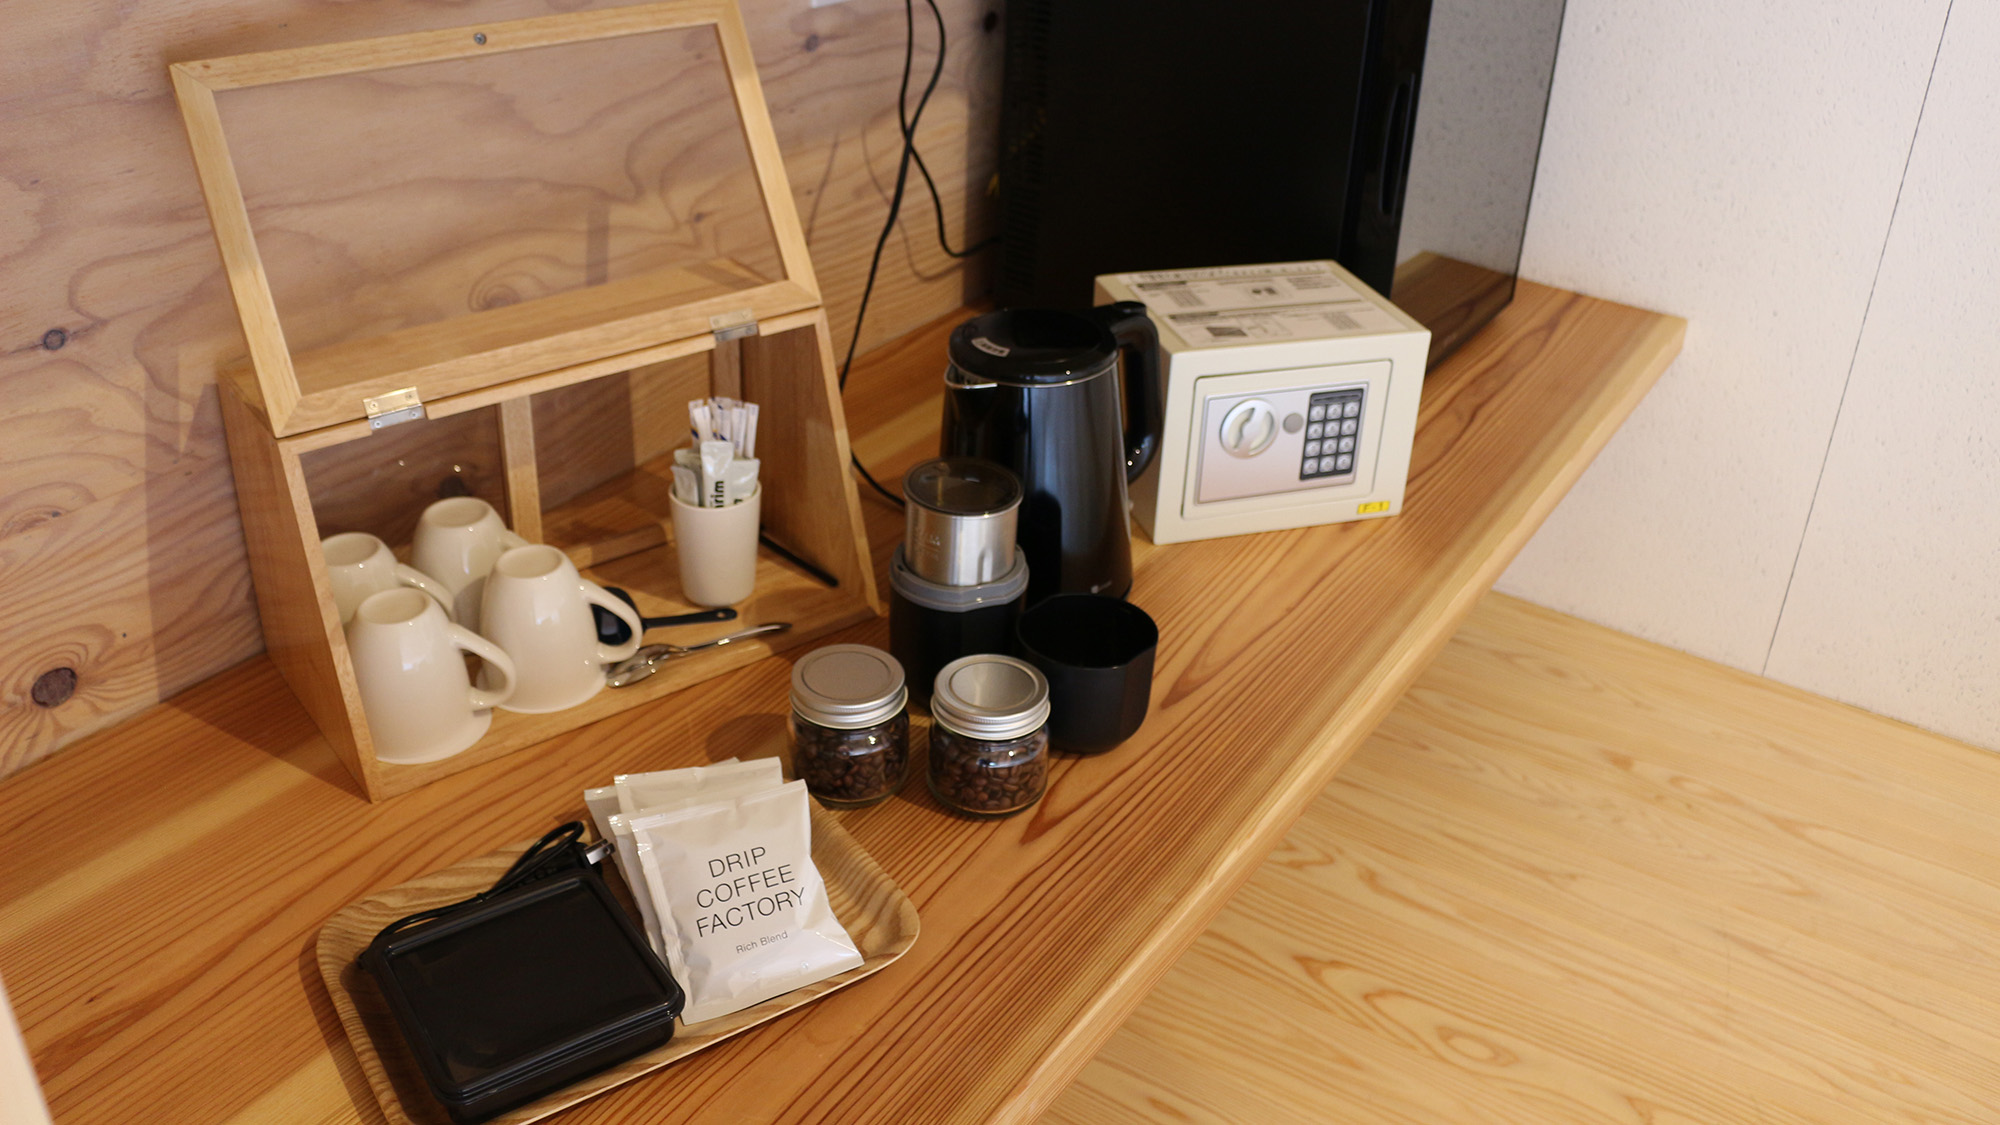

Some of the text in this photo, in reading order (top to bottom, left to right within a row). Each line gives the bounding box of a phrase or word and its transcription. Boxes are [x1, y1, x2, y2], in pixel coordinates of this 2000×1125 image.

[708, 846, 766, 878] DRIP
[696, 864, 795, 908] COFFEE
[696, 887, 805, 937] FACTORY
[735, 931, 789, 954] Rich Blend
